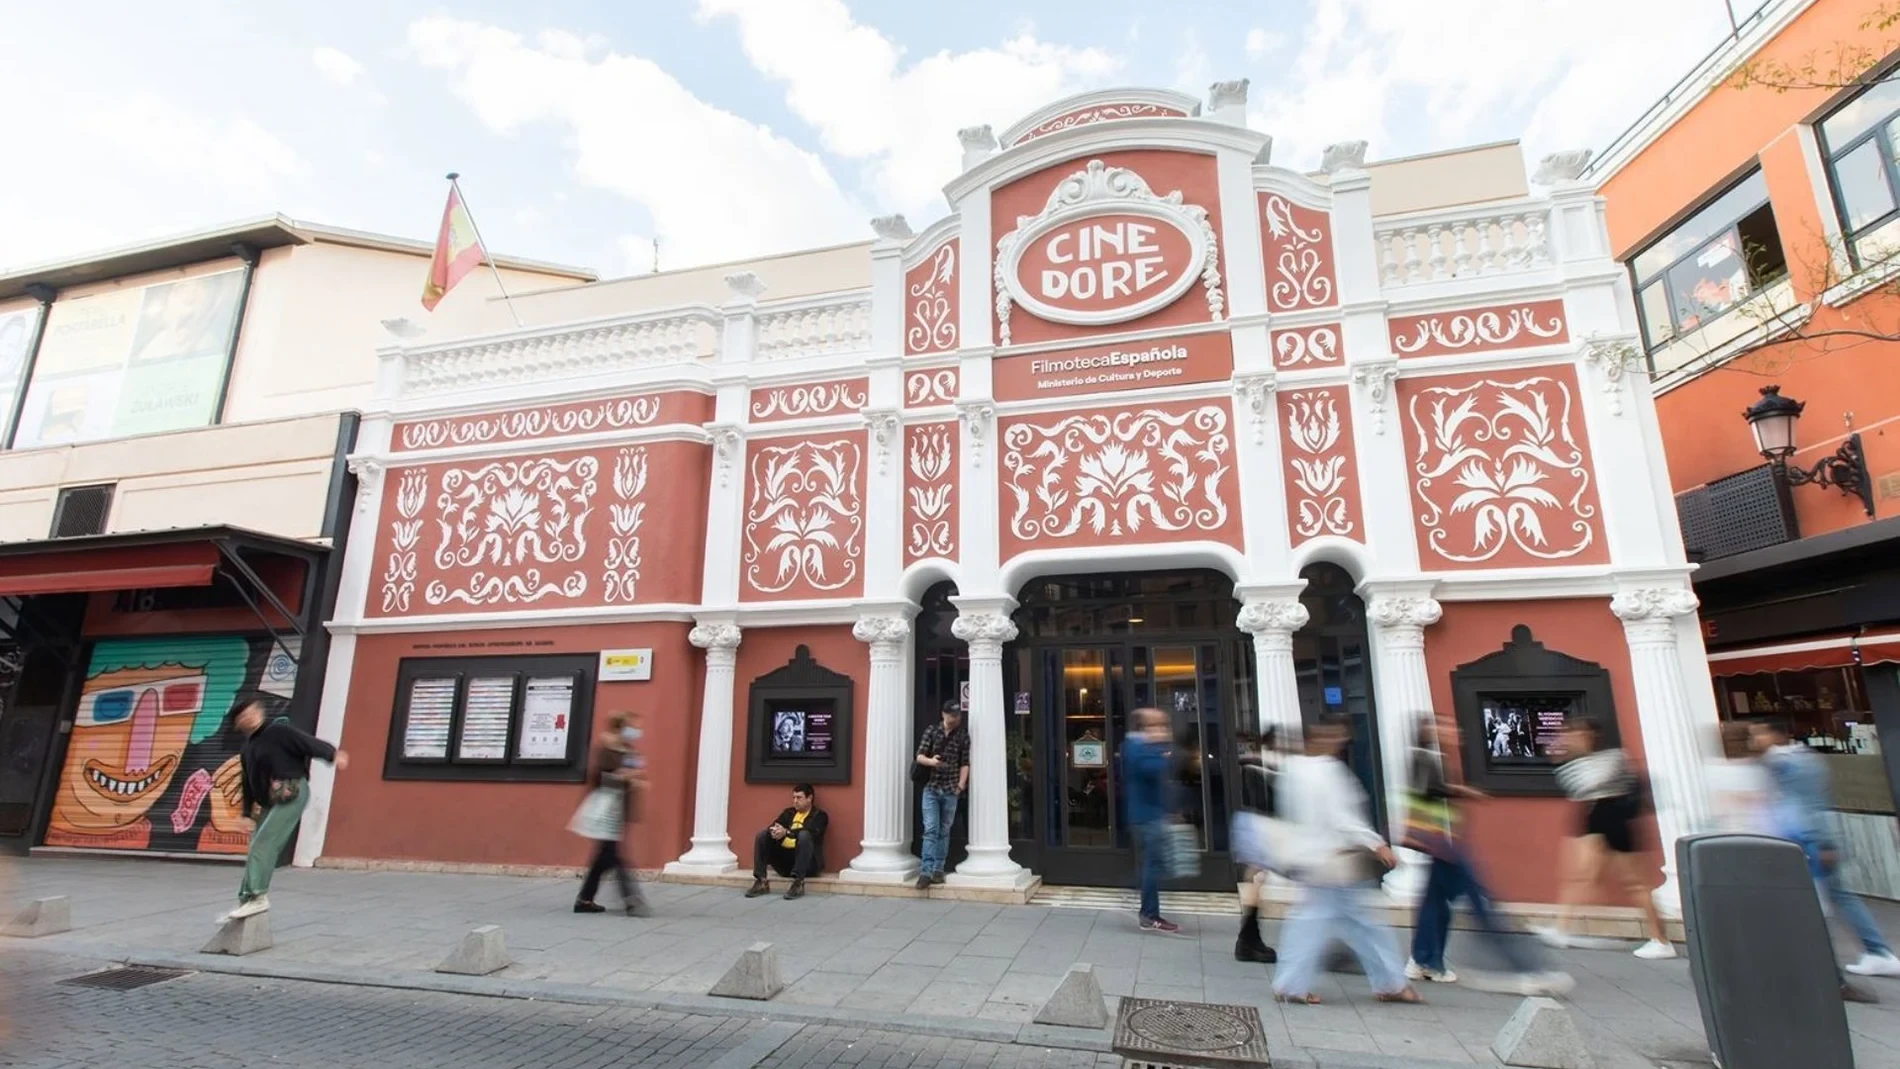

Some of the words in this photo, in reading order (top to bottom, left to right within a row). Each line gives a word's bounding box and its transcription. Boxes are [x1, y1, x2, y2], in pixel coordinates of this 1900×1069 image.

[1046, 222, 1160, 264] CINE
[1042, 256, 1169, 300] DORE
[1031, 345, 1188, 374] FilmotecaEspañola
[1037, 376, 1084, 389] Ministerio
[1085, 375, 1097, 384] de
[1098, 372, 1135, 382] Cultura
[1135, 372, 1142, 380] y
[1143, 367, 1182, 378] Deporte
